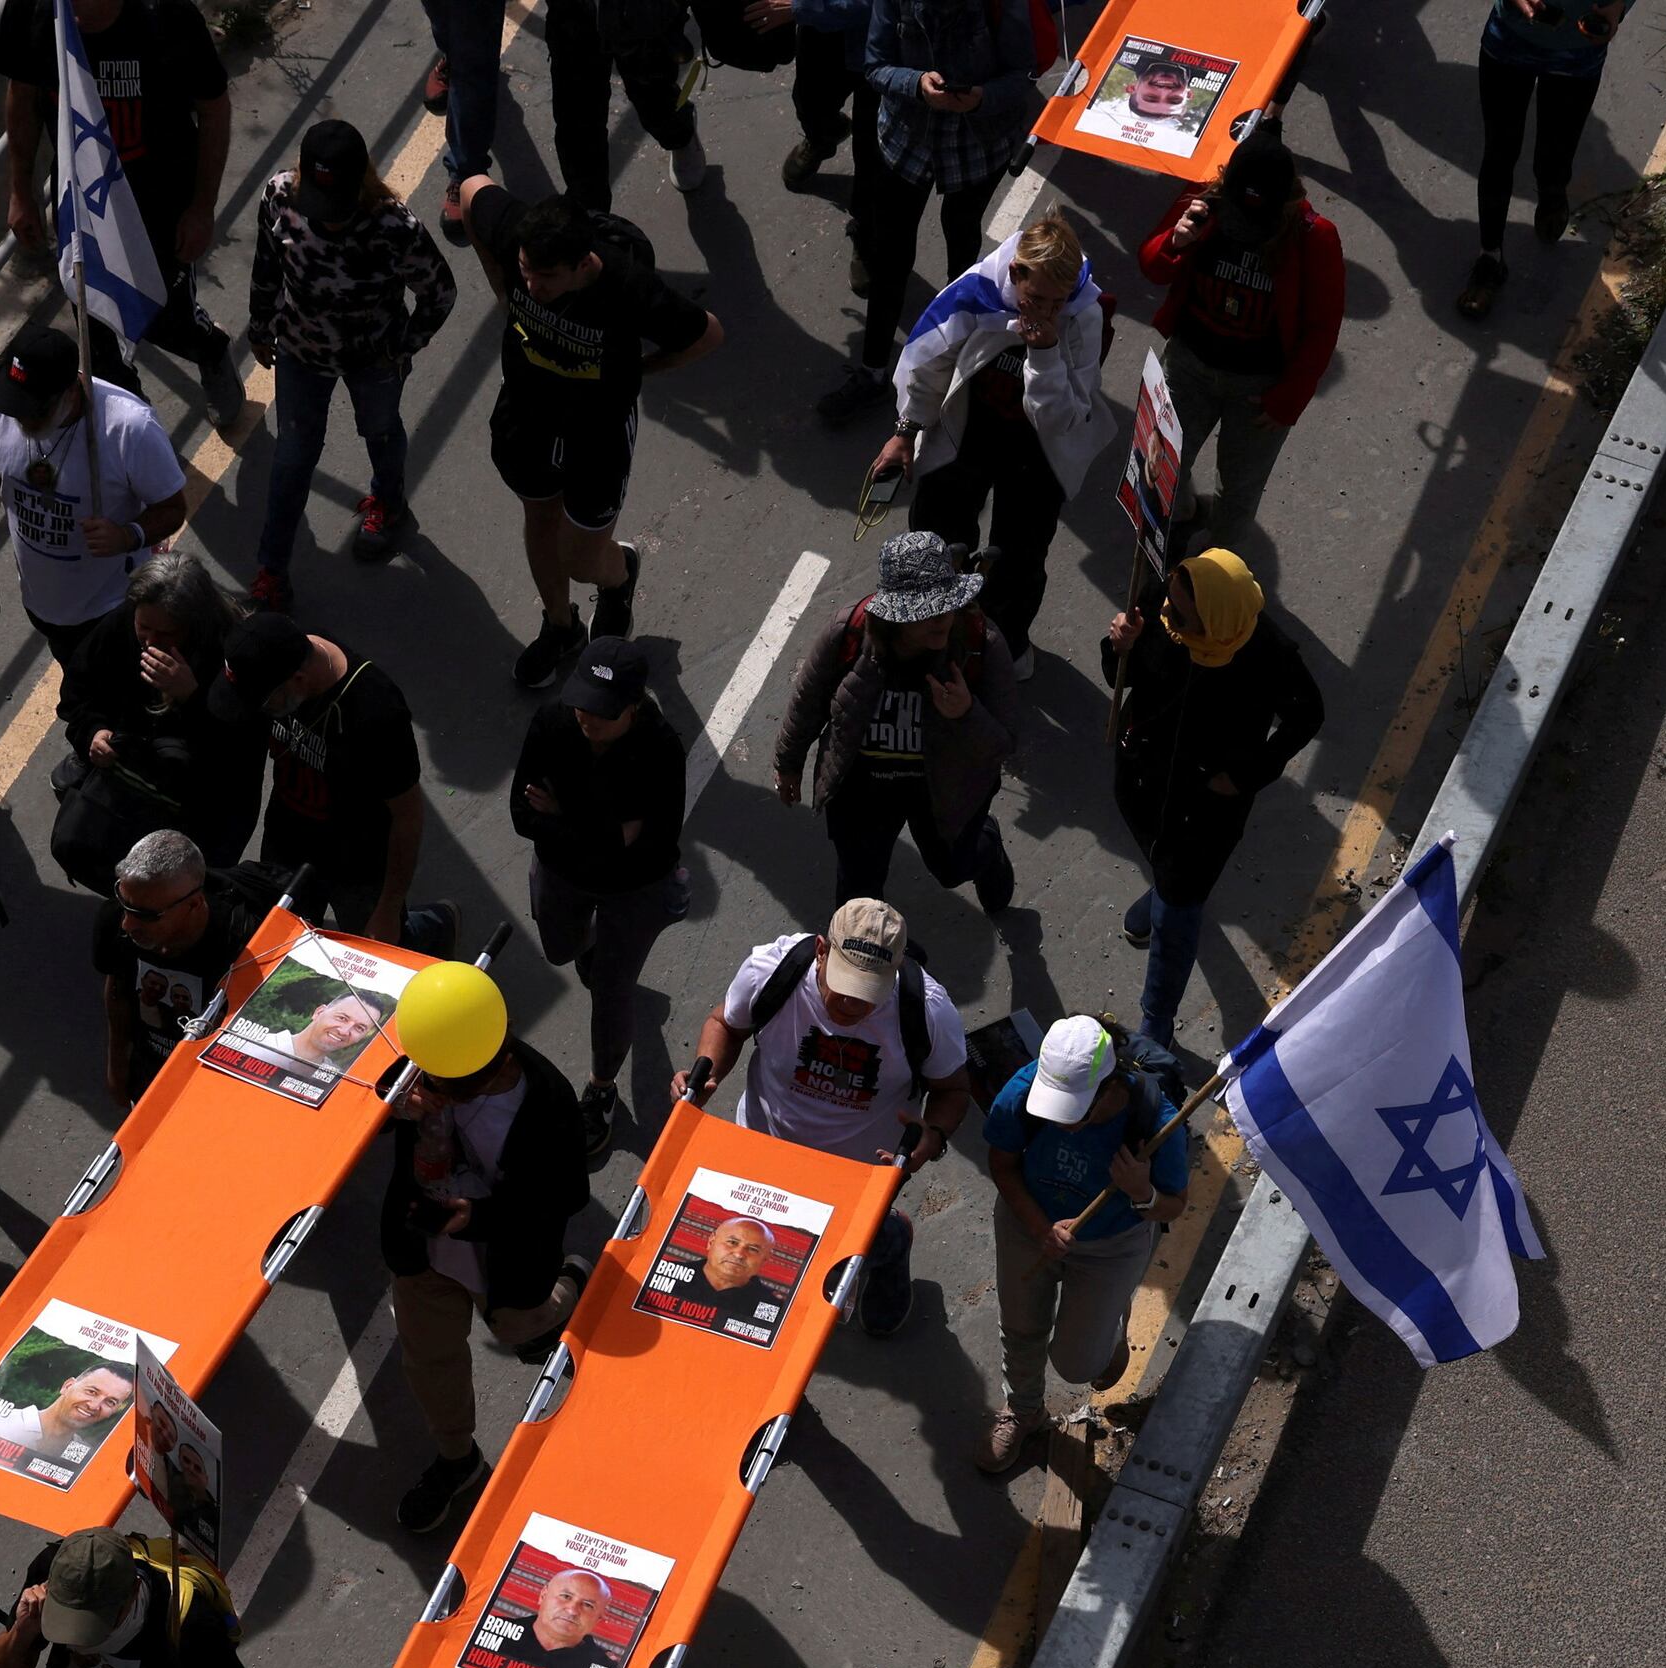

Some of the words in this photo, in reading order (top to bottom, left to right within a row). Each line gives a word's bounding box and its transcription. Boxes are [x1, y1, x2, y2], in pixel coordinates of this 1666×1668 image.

[99, 60, 140, 78] מחזירים
[1205, 70, 1227, 83] HIM
[113, 79, 143, 97] אותם
[1190, 77, 1222, 92] BRING
[348, 962, 377, 979] SHARABI
[232, 1018, 270, 1041] BRING
[208, 1044, 243, 1068] HOME
[242, 1058, 278, 1079] NOW!
[807, 1074, 859, 1101] NOW!
[730, 1190, 752, 1203] YOSEF
[751, 1195, 790, 1214] ALZAYADNI
[771, 1191, 788, 1203] יוסף
[747, 1206, 763, 1217] (53)
[655, 1260, 695, 1283] BRING
[649, 1275, 676, 1294] HIM
[643, 1289, 678, 1313] HOME
[681, 1300, 717, 1322] NOW!
[78, 1326, 99, 1342] YOSSI
[97, 1332, 129, 1351] SHARABI
[88, 1341, 105, 1353] (53)
[565, 1539, 588, 1554] YOSEF
[588, 1547, 628, 1568] ALZAYADNI
[610, 1541, 627, 1554] יוסף
[583, 1557, 599, 1569] (53)
[483, 1615, 525, 1641] BRING
[475, 1630, 504, 1652] HIM
